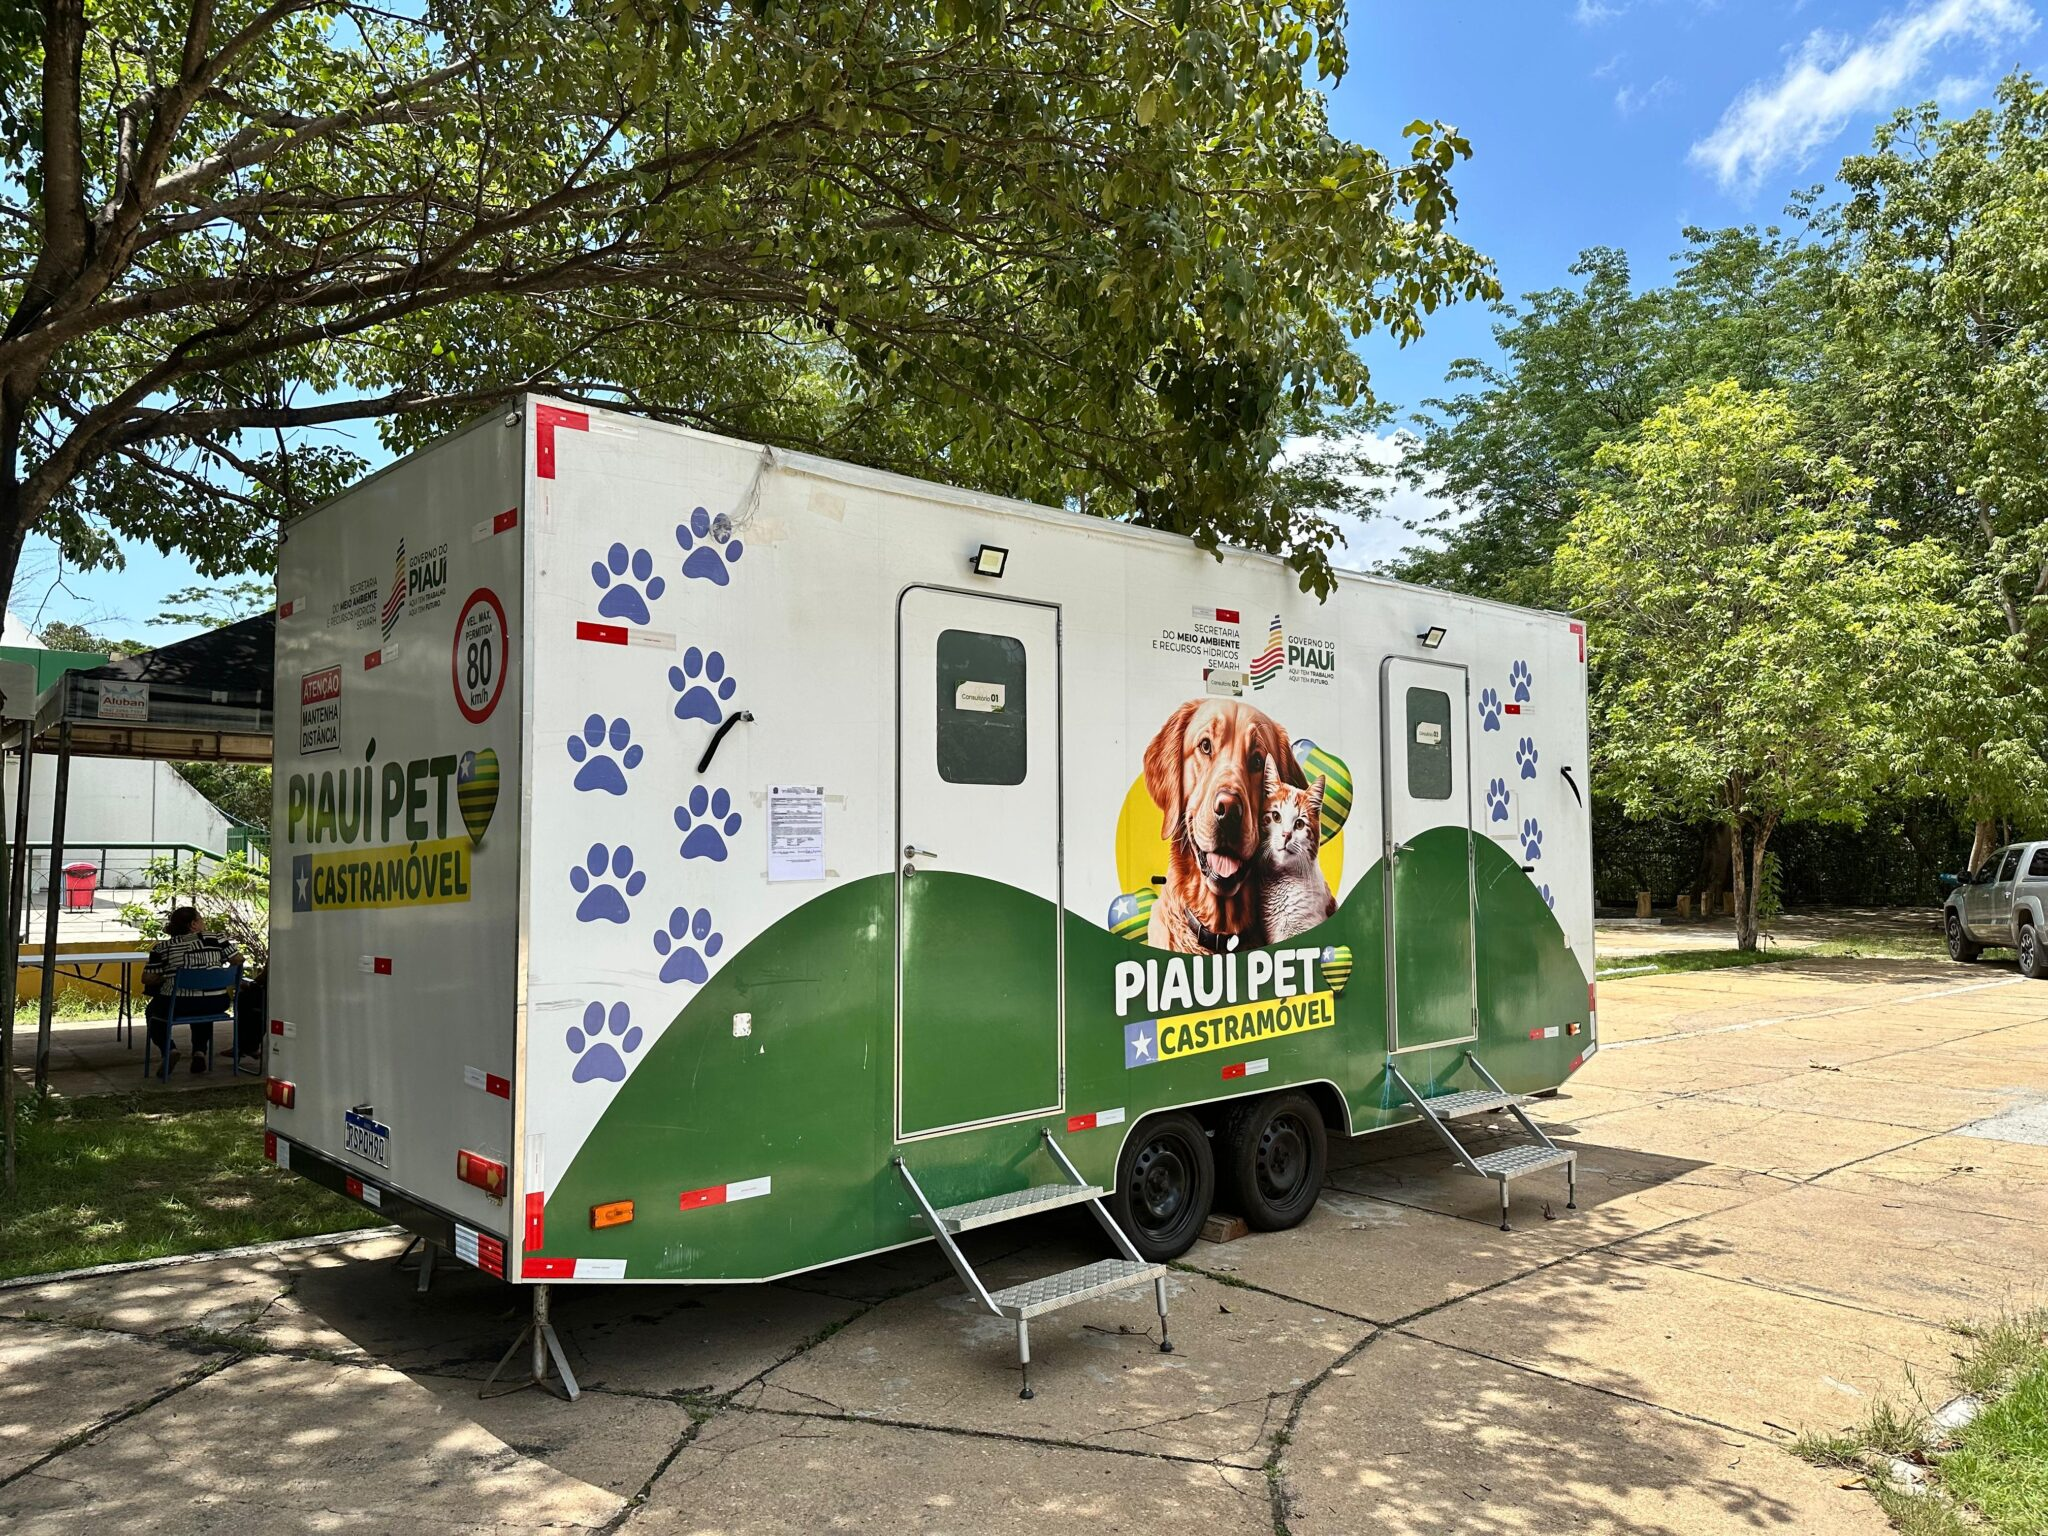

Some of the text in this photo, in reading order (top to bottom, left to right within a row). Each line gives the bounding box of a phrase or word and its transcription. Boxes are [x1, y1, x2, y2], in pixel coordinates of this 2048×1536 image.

[409, 543, 447, 567] GOVERNO DO
[409, 556, 447, 597] PIAUÍ
[340, 597, 353, 611] MEIO
[353, 589, 378, 605] AMBIENTE
[465, 623, 492, 641] PERMITIDA
[1162, 630, 1241, 650] DO MEIO AMBIENTE
[1194, 624, 1240, 638] SECRETARIA
[1152, 640, 1239, 660] E RECURSOS HÍDRICOS
[1288, 635, 1335, 650] GOVERNO DO
[467, 638, 491, 690] 80
[1208, 659, 1240, 671] SEMARH
[1288, 645, 1335, 672] PIAUÍ
[303, 673, 339, 701] ATENÇÃO
[1231, 680, 1240, 688] 02
[103, 697, 145, 707] Aluban
[470, 687, 489, 706] km/h
[990, 694, 999, 702] 01
[302, 704, 338, 727] MANTENHA
[302, 725, 337, 748] DISTÂNCIA
[288, 737, 457, 844] PIAUÍ PET
[313, 841, 468, 905] CASTRAMÓVEL
[1115, 934, 1321, 1017] PIAUÍ PET
[1160, 996, 1332, 1055] CASTRAMÓVEL
